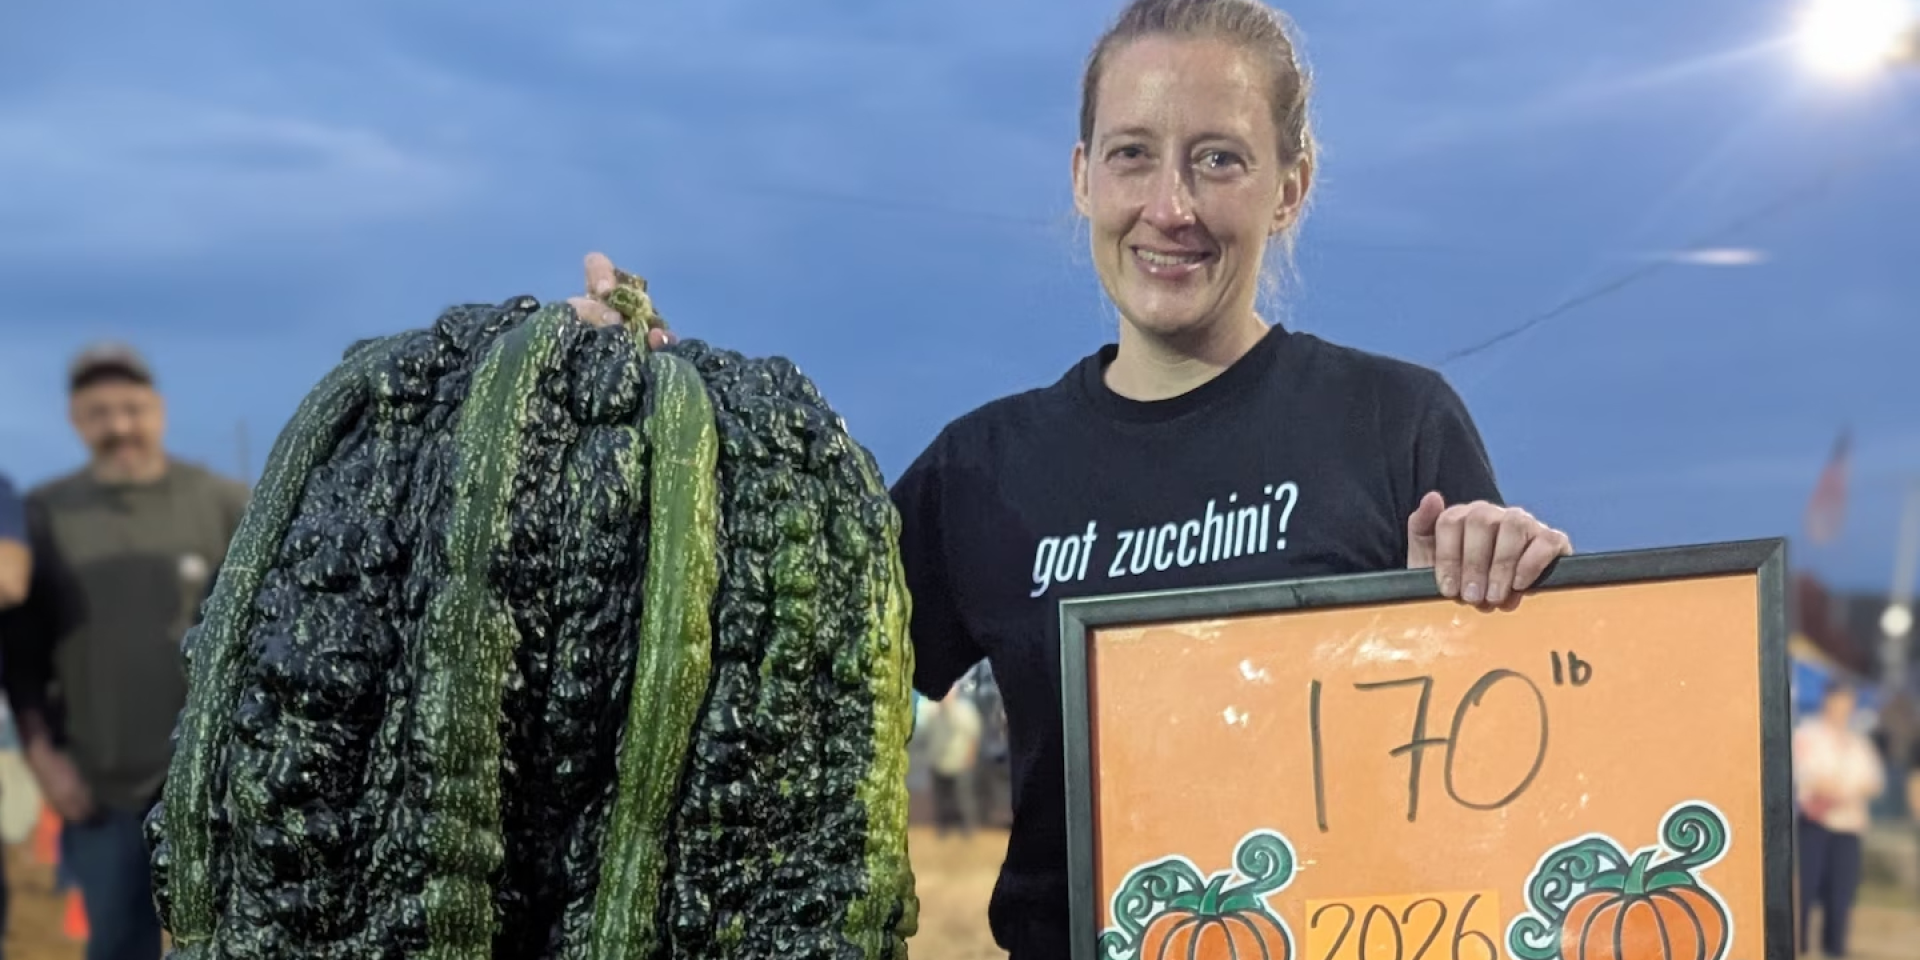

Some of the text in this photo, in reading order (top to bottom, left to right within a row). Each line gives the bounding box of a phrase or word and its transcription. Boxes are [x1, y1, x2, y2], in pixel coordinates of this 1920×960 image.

[1029, 480, 1299, 598] got zucchini?
[1309, 650, 1593, 833] 170 lb
[1311, 894, 1498, 960] 2026
